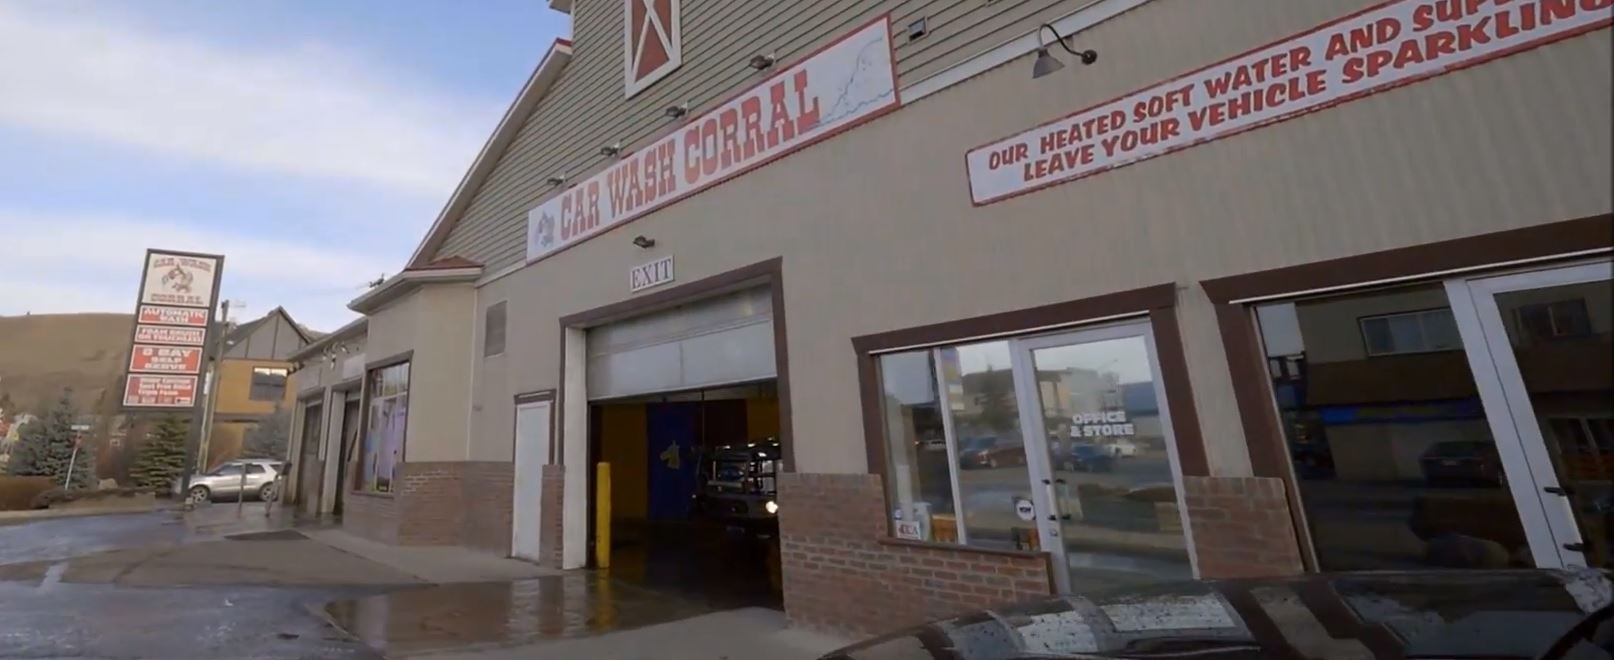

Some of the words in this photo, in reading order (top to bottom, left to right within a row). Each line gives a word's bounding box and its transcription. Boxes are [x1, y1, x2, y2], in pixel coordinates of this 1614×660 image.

[989, 143, 1028, 171] OUR
[1040, 109, 1126, 155] HEATED
[1133, 84, 1195, 124] SOFT
[1204, 46, 1311, 99] WATER
[1325, 18, 1401, 60] AND
[1023, 143, 1095, 183] LEAVE
[1101, 117, 1180, 158] YOUR
[1187, 70, 1326, 132] VEHICLE
[560, 182, 600, 241] CAR
[608, 139, 677, 219] WASH
[684, 69, 820, 184] CORRAL
[632, 259, 671, 289] EXIT
[144, 308, 204, 319] AUTOMATIC
[158, 348, 191, 357] BAY
[1072, 411, 1126, 424] OFFICE
[1070, 425, 1081, 437] &
[1083, 423, 1134, 437] STORE
